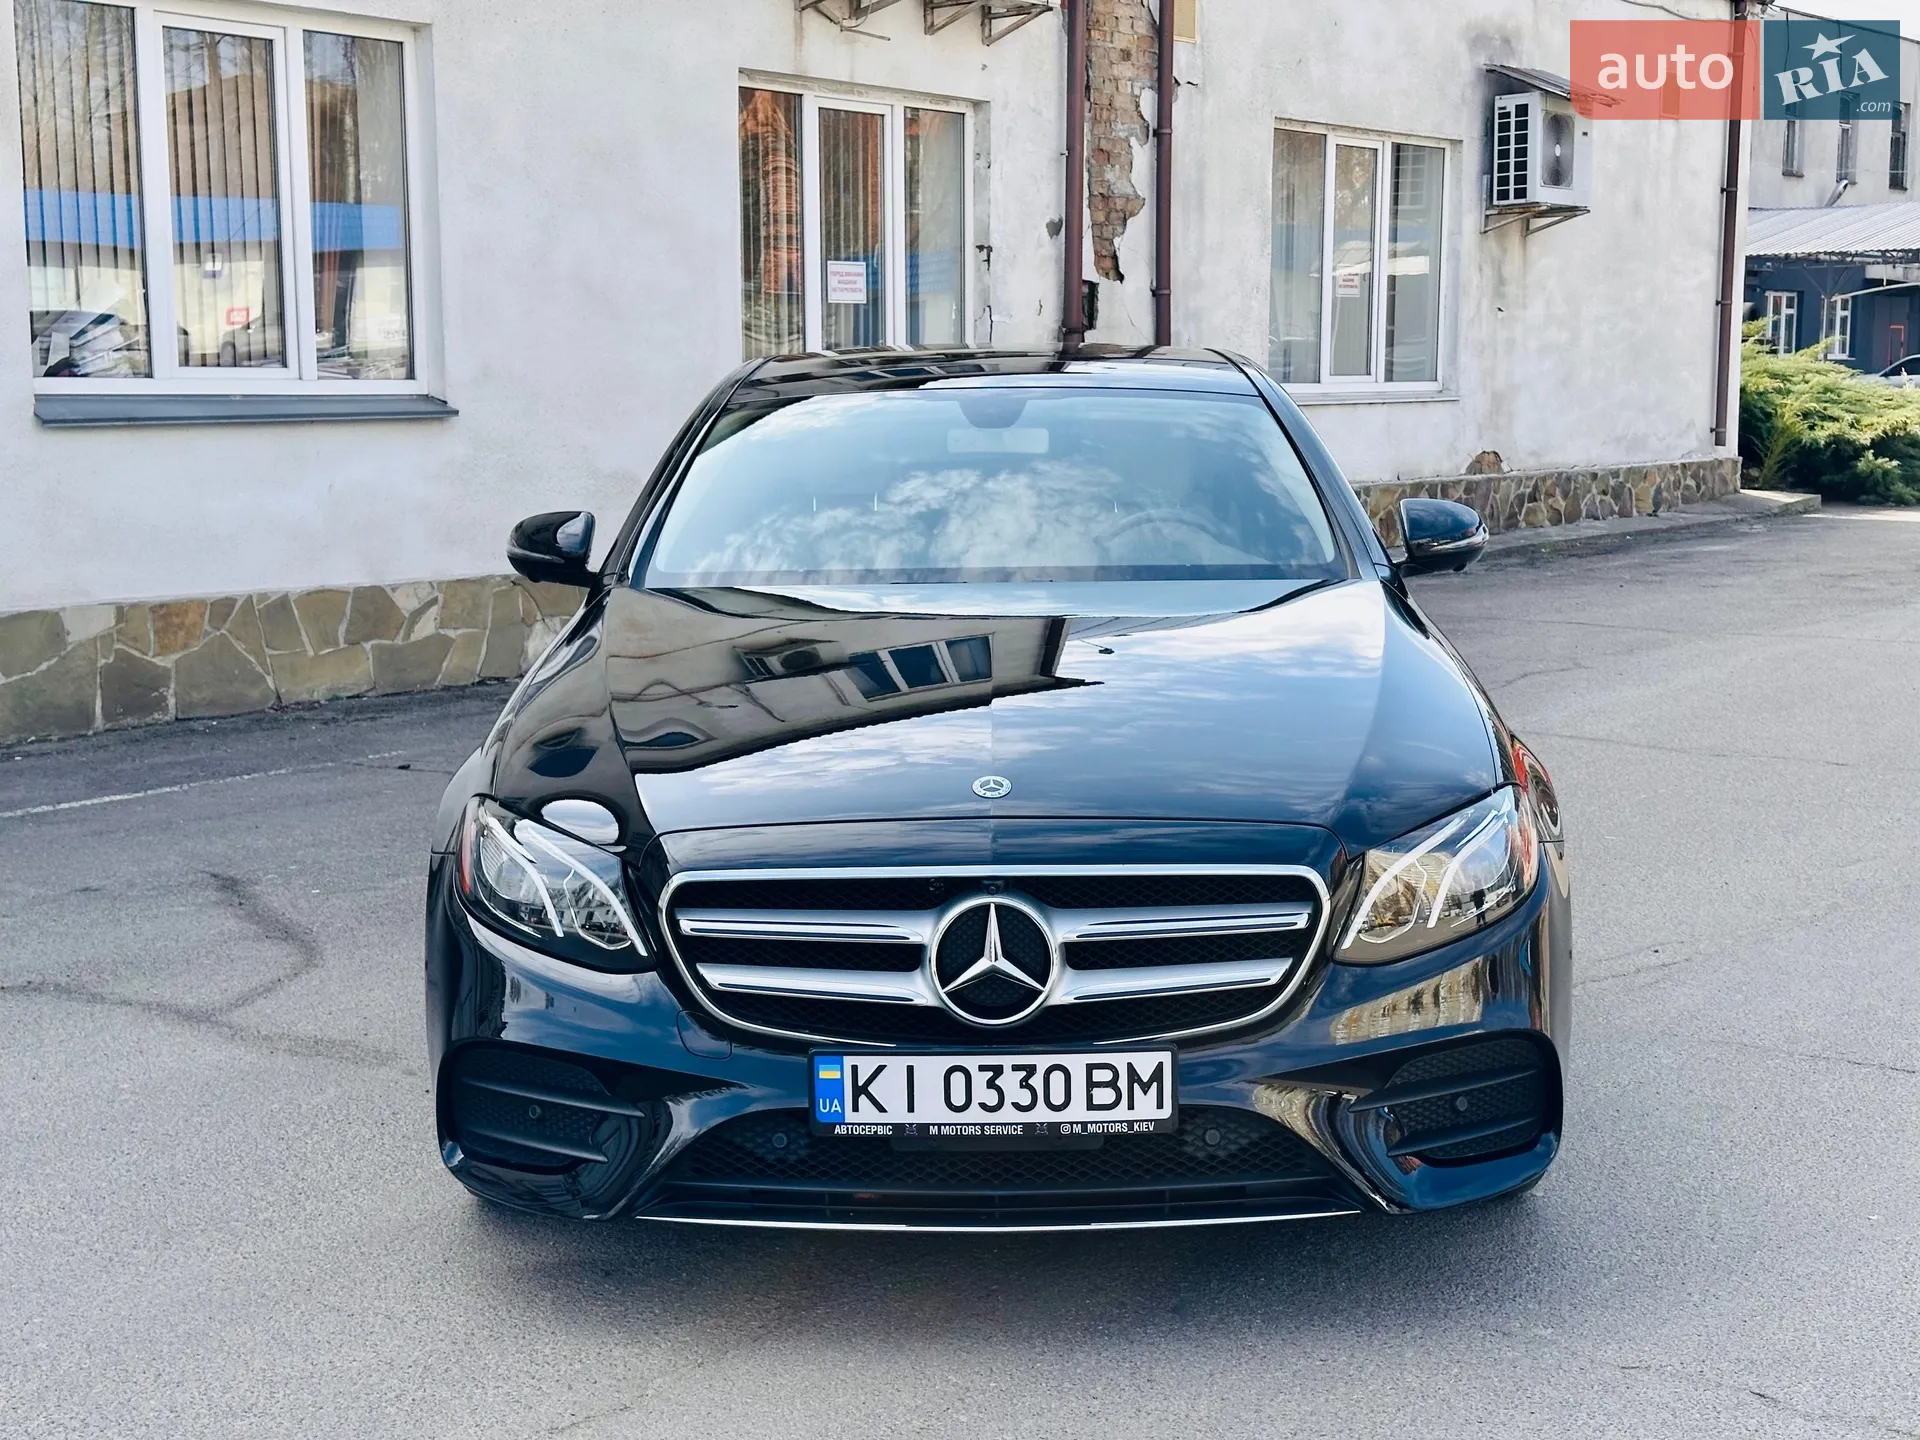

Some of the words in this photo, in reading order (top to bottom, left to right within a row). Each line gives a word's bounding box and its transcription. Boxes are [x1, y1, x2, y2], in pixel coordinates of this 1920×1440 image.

[851, 1064, 915, 1113] KI
[943, 1063, 1072, 1113] 0330
[1085, 1061, 1164, 1112] BM
[819, 1099, 842, 1113] UA
[834, 1124, 892, 1135] АВТОСЕРВІС
[929, 1125, 939, 1135] M
[941, 1125, 982, 1135] MOTORS
[983, 1125, 1023, 1135] SERVICE
[1072, 1121, 1155, 1135] M_MOTORS_KIEV
